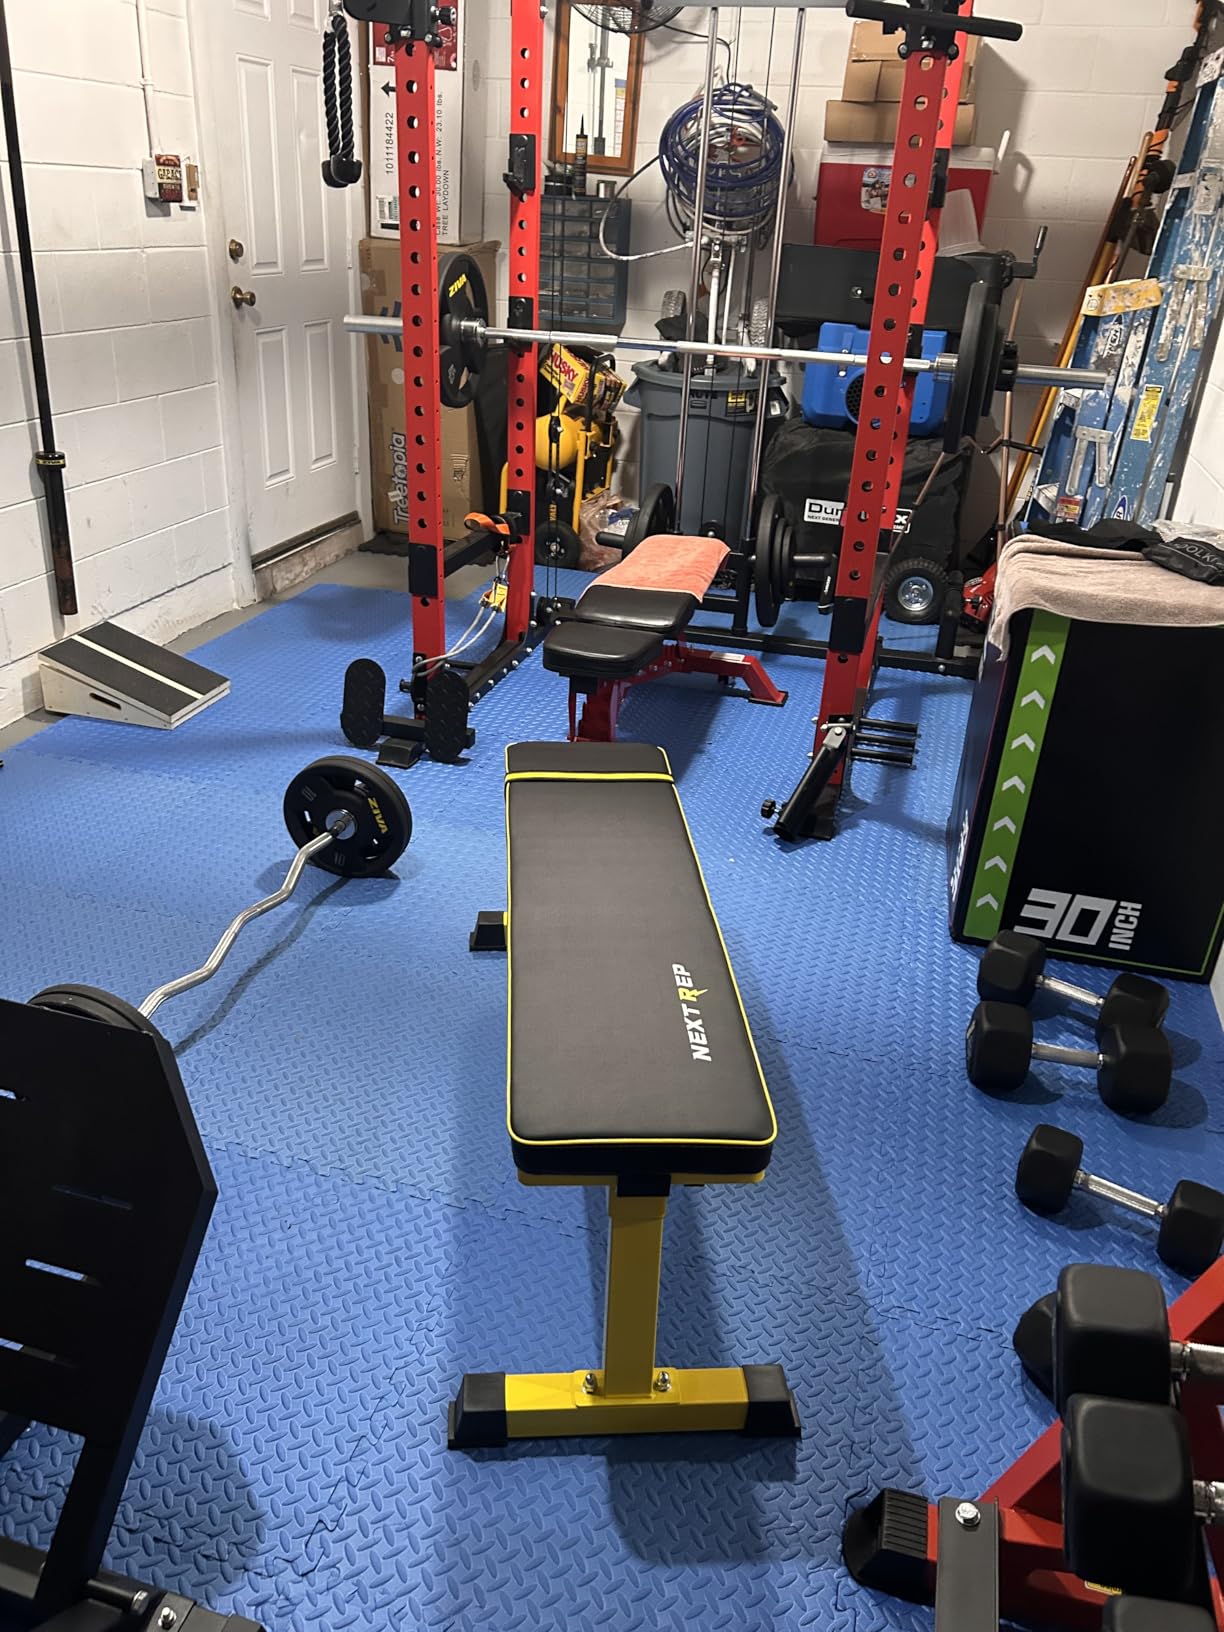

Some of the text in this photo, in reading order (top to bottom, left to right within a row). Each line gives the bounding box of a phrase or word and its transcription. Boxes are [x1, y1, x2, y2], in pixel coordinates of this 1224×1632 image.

[385, 112, 394, 175] 1011184422
[442, 169, 450, 211] LAYDOWN
[449, 273, 467, 298] ZIVA
[551, 351, 580, 382] HUSKY
[389, 432, 409, 524] Treetopia
[368, 797, 389, 834] ZIVA
[1013, 888, 1142, 950] 30 INCH
[672, 963, 712, 1062] NEXT REP
